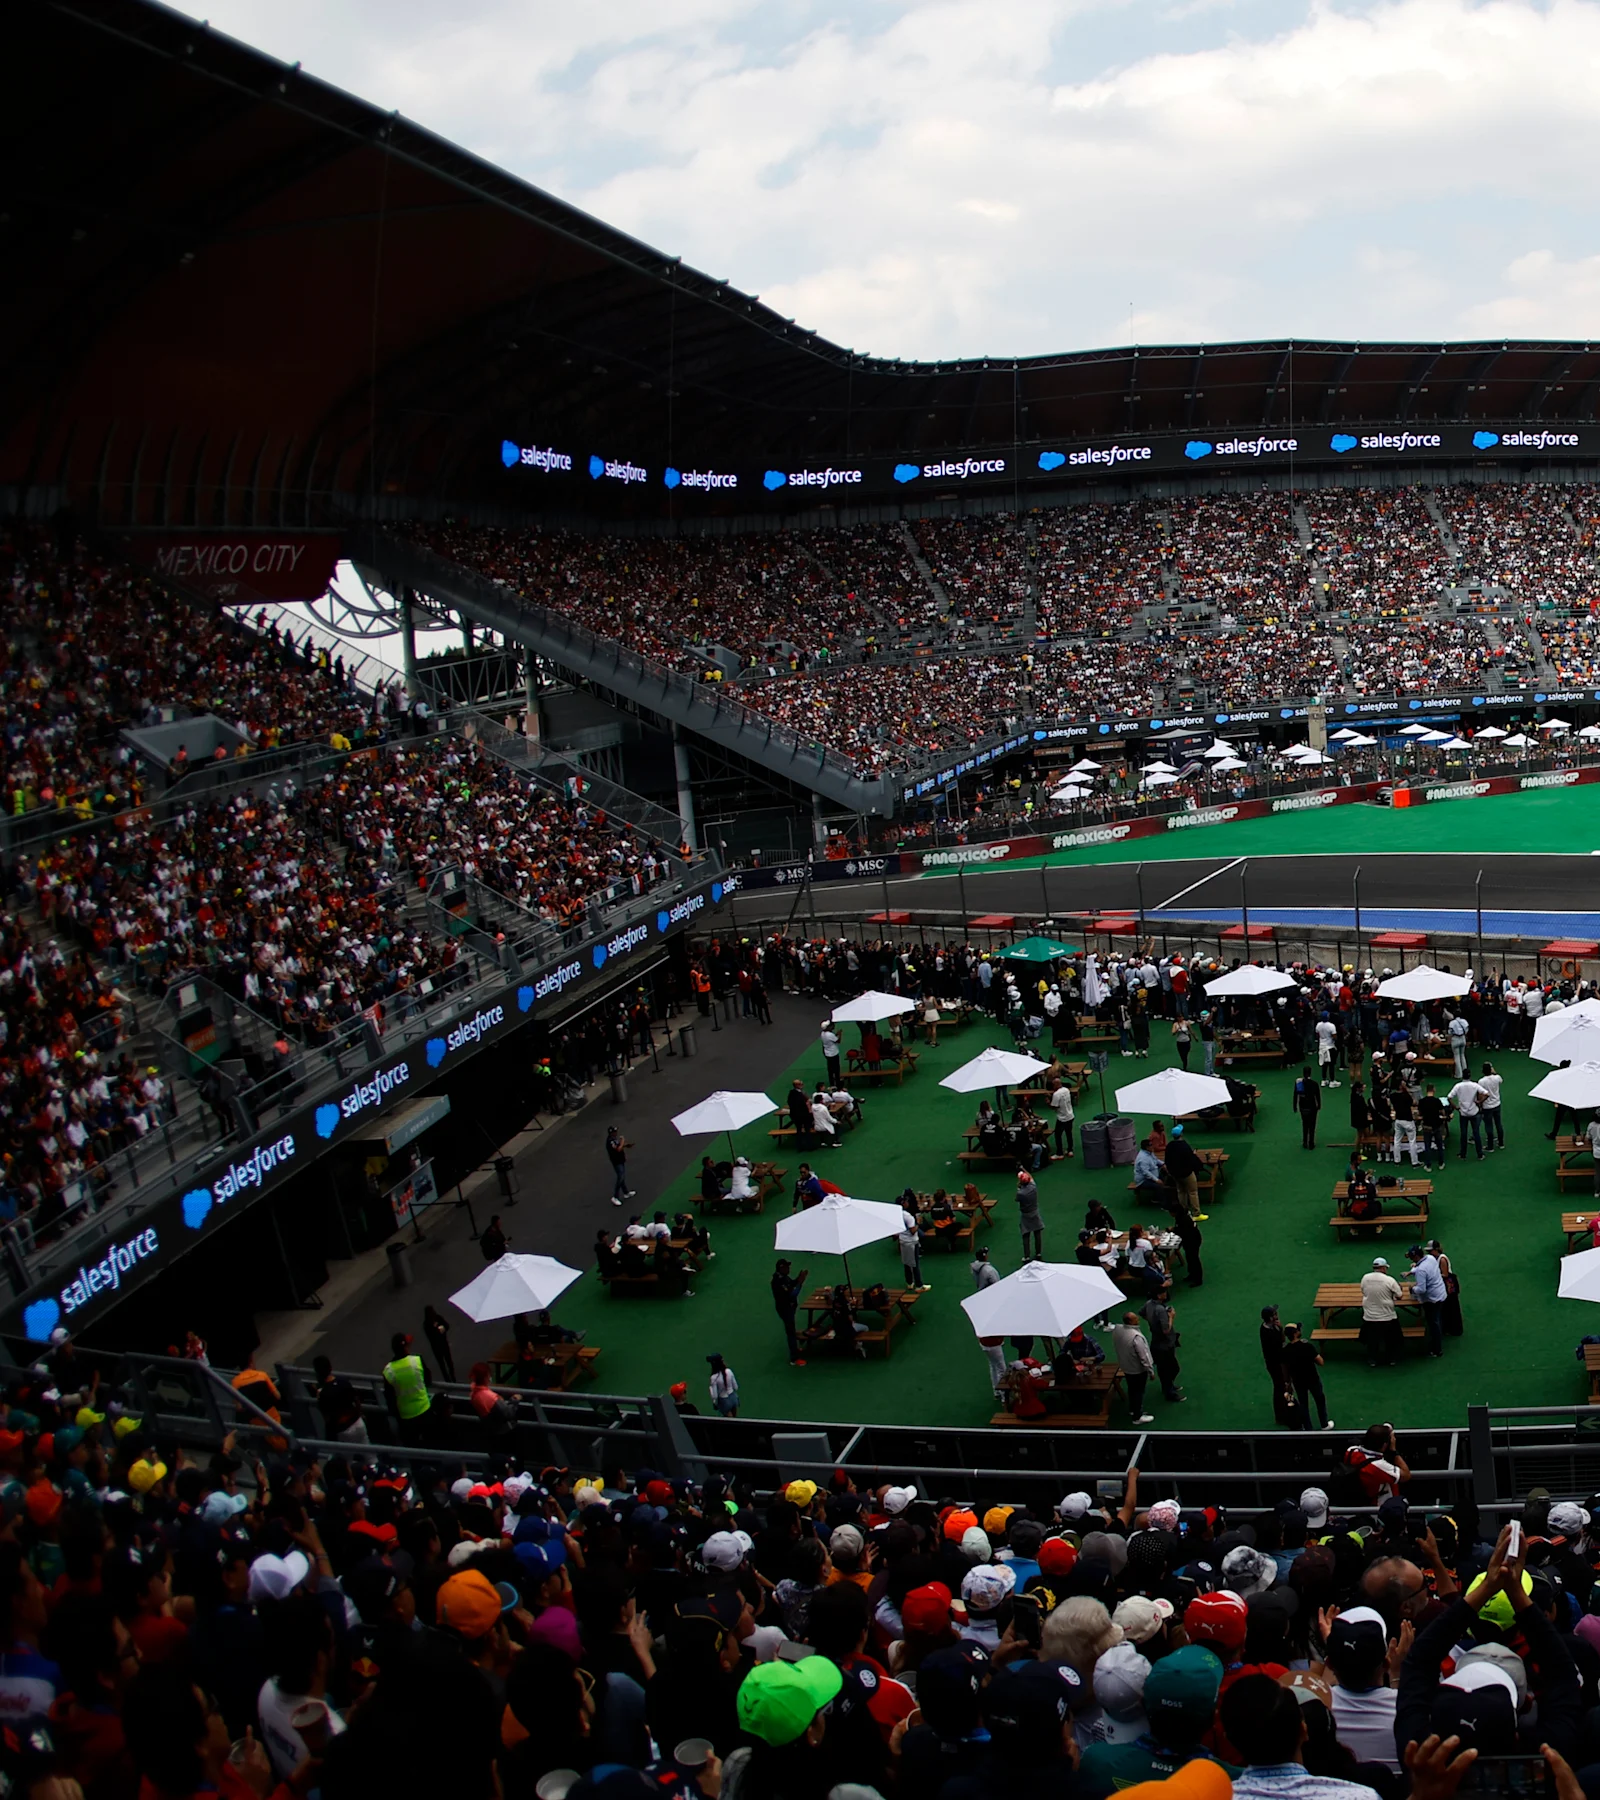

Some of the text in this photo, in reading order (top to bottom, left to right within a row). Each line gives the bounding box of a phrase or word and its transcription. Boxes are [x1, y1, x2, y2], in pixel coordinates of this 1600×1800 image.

[1216, 437, 1297, 457] salesforce
[1361, 432, 1440, 452] salesforce
[1502, 431, 1578, 450] salesforce
[522, 446, 571, 472] salesforce
[1069, 446, 1151, 466] salesforce
[606, 460, 646, 484] salesforce
[789, 468, 861, 488] salesforce
[924, 458, 1004, 479] salesforce
[682, 470, 737, 491] salesforce
[157, 544, 306, 575] MEXICO CITY
[1423, 698, 1461, 710] salesforce
[1486, 694, 1524, 706] salesforce
[1548, 690, 1584, 702] salesforce
[1230, 711, 1270, 723] salesforce
[1360, 701, 1399, 714] salesforce
[1164, 716, 1206, 729] salesforce
[1048, 727, 1088, 739] salesforce
[1520, 772, 1579, 789] #MexicoGP
[1272, 792, 1337, 811] #MexicoGP
[1426, 782, 1490, 801] #MexicoGP
[1167, 807, 1238, 828] #MexicoGP
[1053, 825, 1130, 849] #MexicoGP
[857, 859, 885, 872] MSC
[922, 845, 1010, 866] #MexicoGP
[670, 894, 704, 923] salesforce
[608, 924, 648, 957] salesforce
[535, 960, 581, 999] salesforce
[447, 1005, 504, 1051] salesforce
[341, 1062, 410, 1118] salesforce
[213, 1135, 296, 1204] salesforce
[61, 1228, 159, 1314] salesforce
[1161, 1698, 1183, 1708] BOSS
[1151, 1761, 1173, 1772] BOSS
